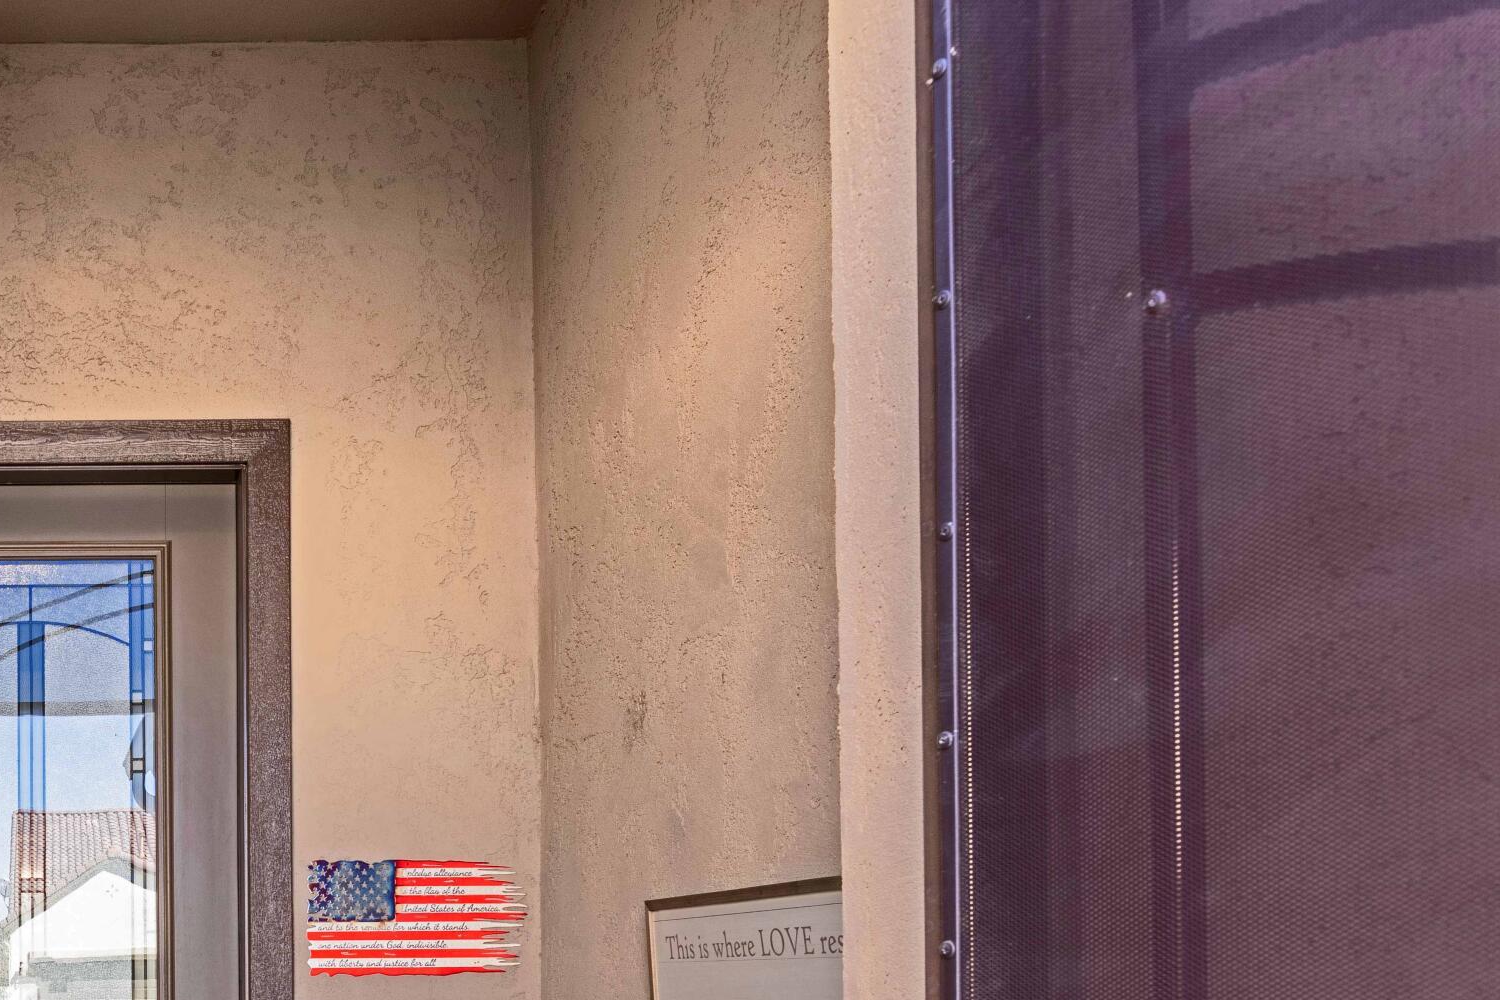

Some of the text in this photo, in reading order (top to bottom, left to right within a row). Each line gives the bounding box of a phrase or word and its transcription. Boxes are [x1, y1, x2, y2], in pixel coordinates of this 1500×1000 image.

[409, 887, 422, 895] the
[452, 887, 465, 895] the
[430, 904, 455, 912] States
[456, 904, 466, 912] of
[318, 922, 334, 931] and
[346, 921, 360, 931] the
[407, 922, 431, 931] which
[433, 922, 440, 931] it
[442, 922, 468, 931] stands
[334, 941, 357, 949] nation
[361, 941, 383, 949] under
[665, 933, 695, 960] This
[698, 935, 709, 959] is
[712, 930, 756, 958] where
[758, 926, 815, 957] LOVE
[319, 959, 436, 968] with liberty and justice for all
